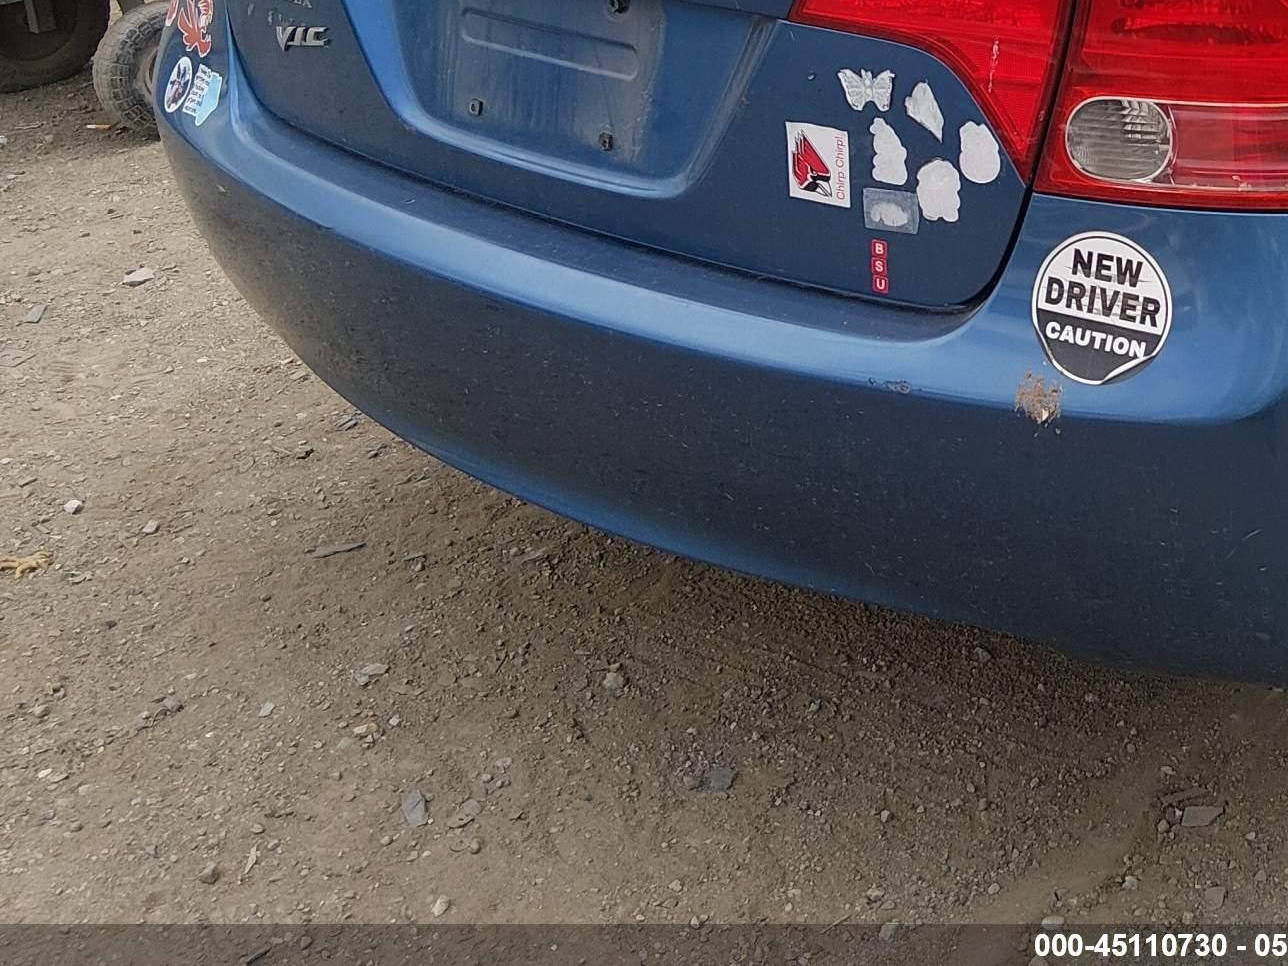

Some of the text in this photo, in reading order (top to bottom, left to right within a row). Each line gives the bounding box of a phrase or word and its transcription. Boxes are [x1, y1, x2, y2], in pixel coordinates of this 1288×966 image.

[835, 136, 847, 200] Chirp Chirp!
[1071, 248, 1144, 288] NEW
[1044, 275, 1161, 328] DRIVER
[1045, 321, 1147, 358] CAUTION
